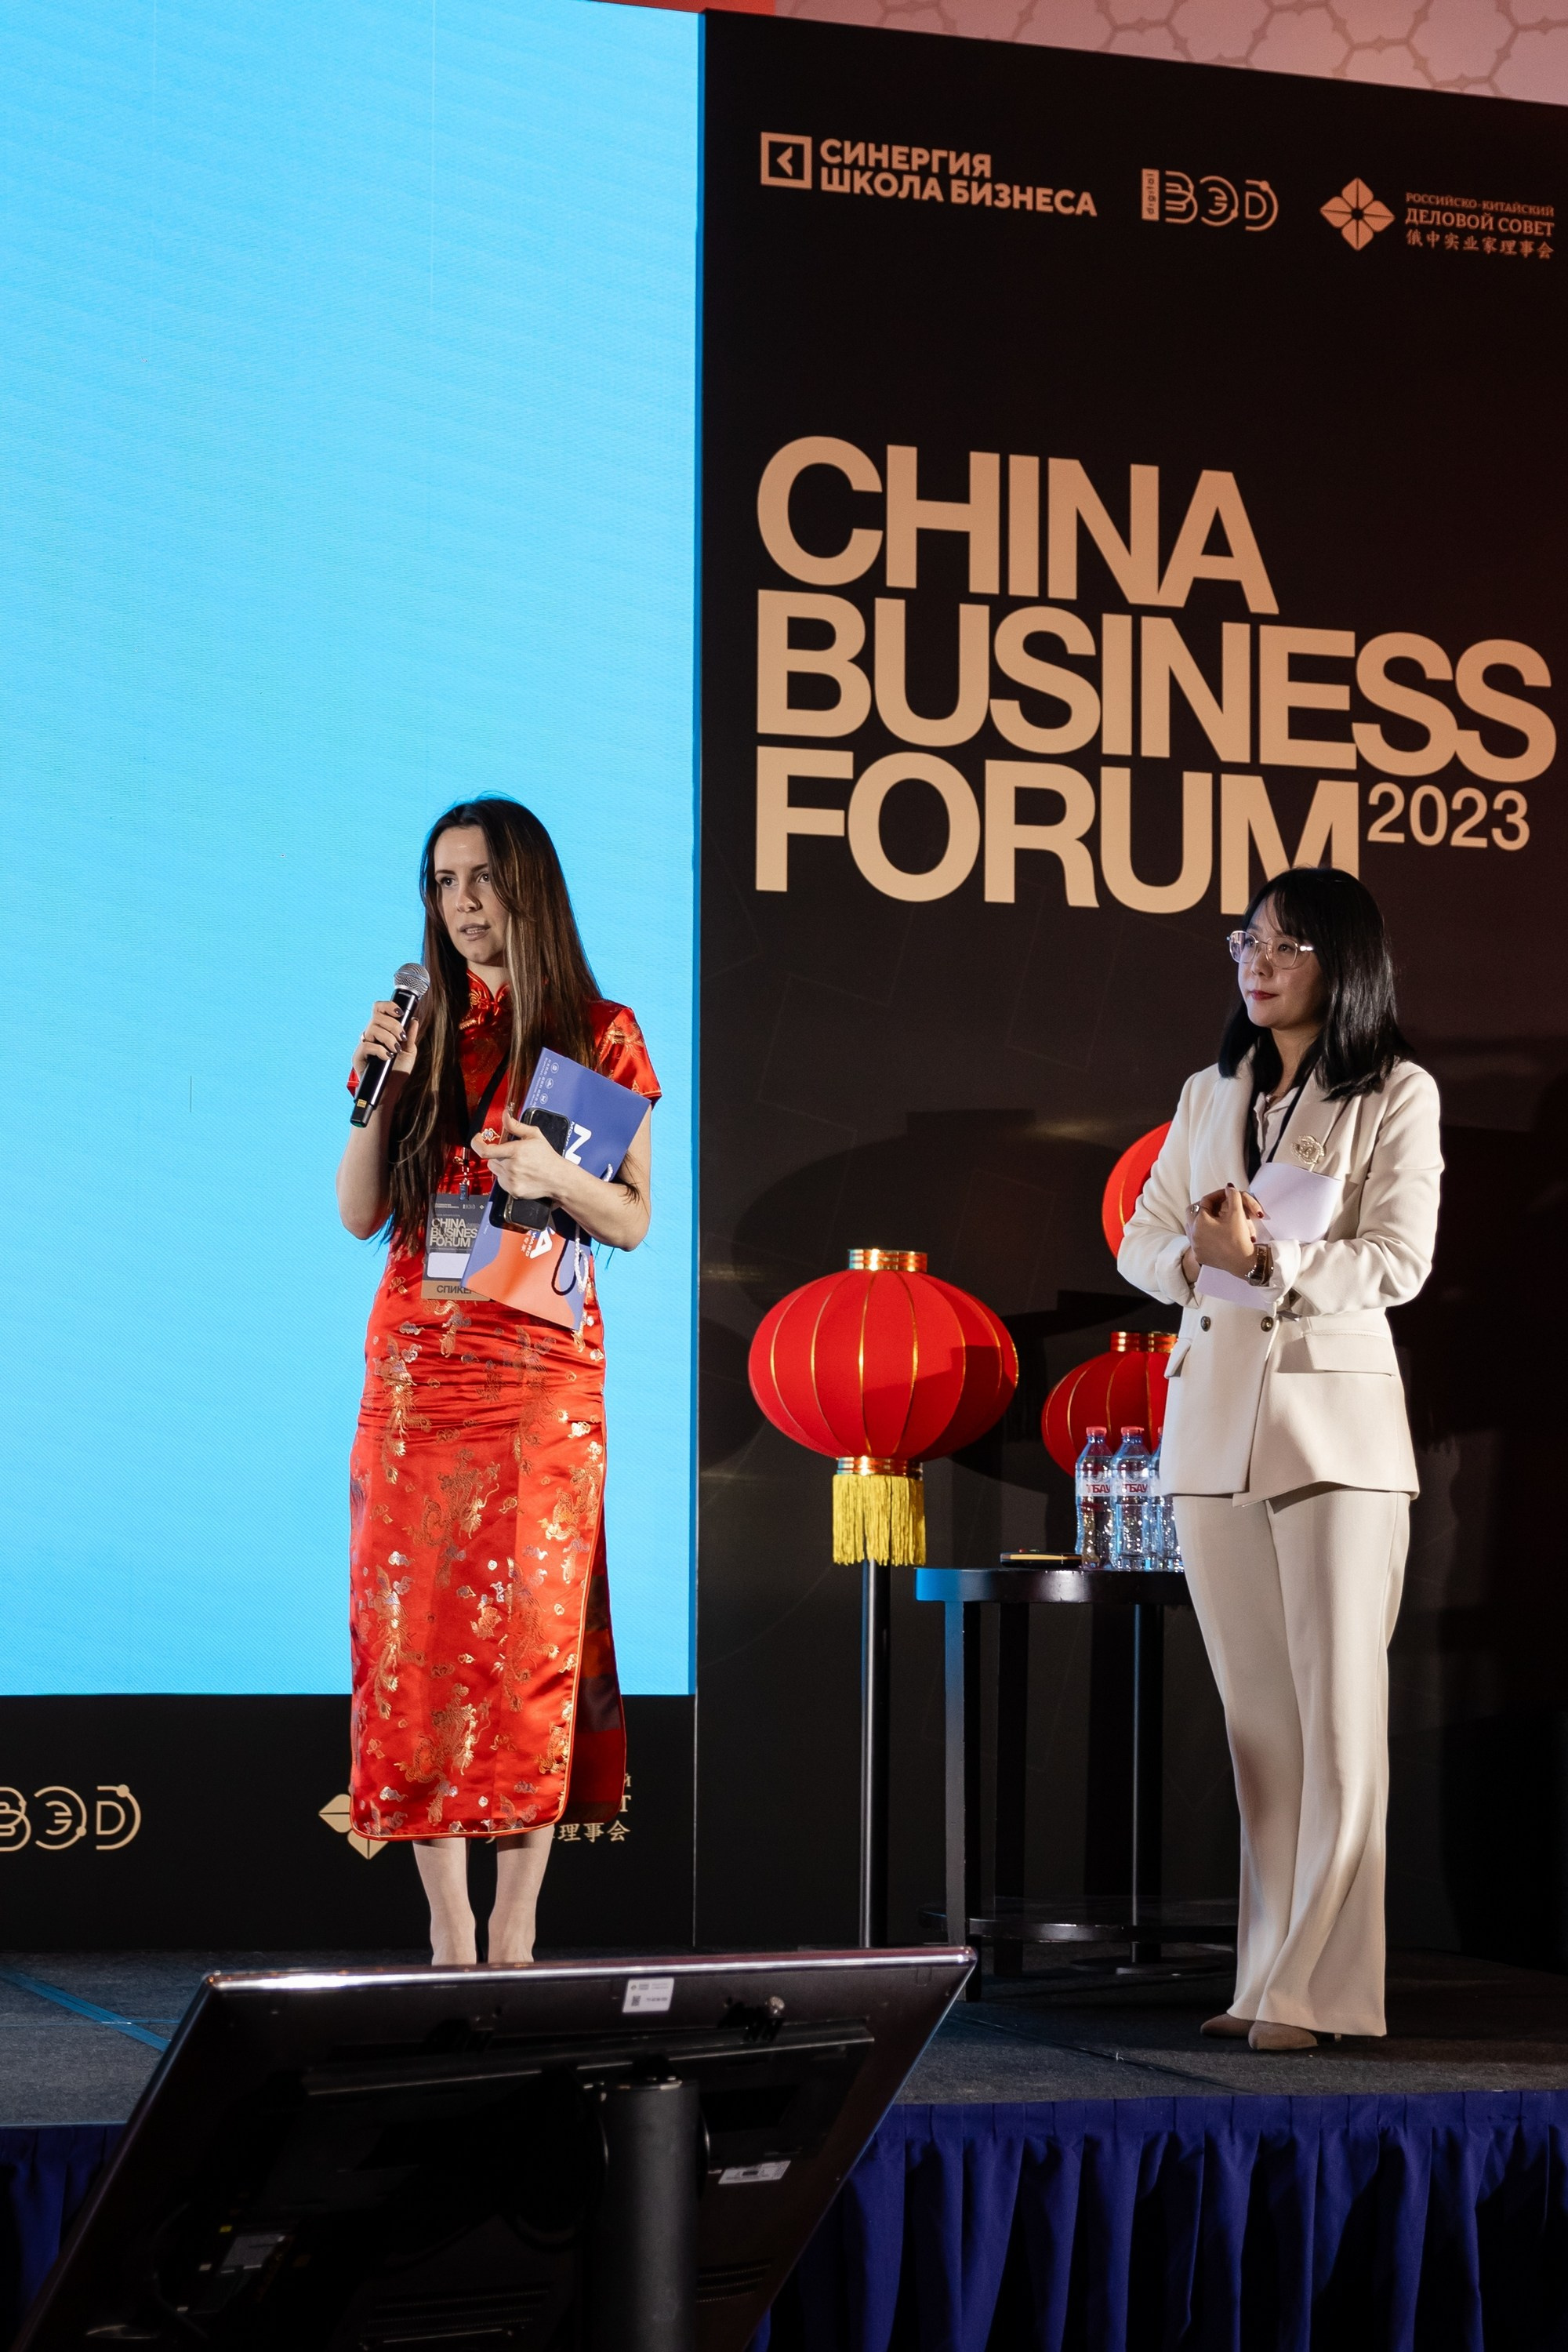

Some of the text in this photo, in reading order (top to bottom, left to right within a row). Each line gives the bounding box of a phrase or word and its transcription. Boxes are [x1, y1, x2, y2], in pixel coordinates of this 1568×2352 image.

[820, 138, 992, 179] СИНЕРГИЯ
[821, 166, 1098, 216] ШКОЛА БИЗНЕСА
[1146, 173, 1156, 214] digital
[1405, 207, 1555, 238] ДЕЛОВОЙ СОВЕТ
[757, 436, 1279, 615] CHINA
[757, 589, 1557, 783] BUSINESS
[755, 746, 1530, 916] FORUM 2023
[430, 1226, 477, 1239] BUSINES
[431, 1218, 466, 1229] CHINA
[429, 1236, 470, 1248] FORUM
[436, 1284, 472, 1294] СПИКЕ
[553, 1820, 630, 1843] 理事会
